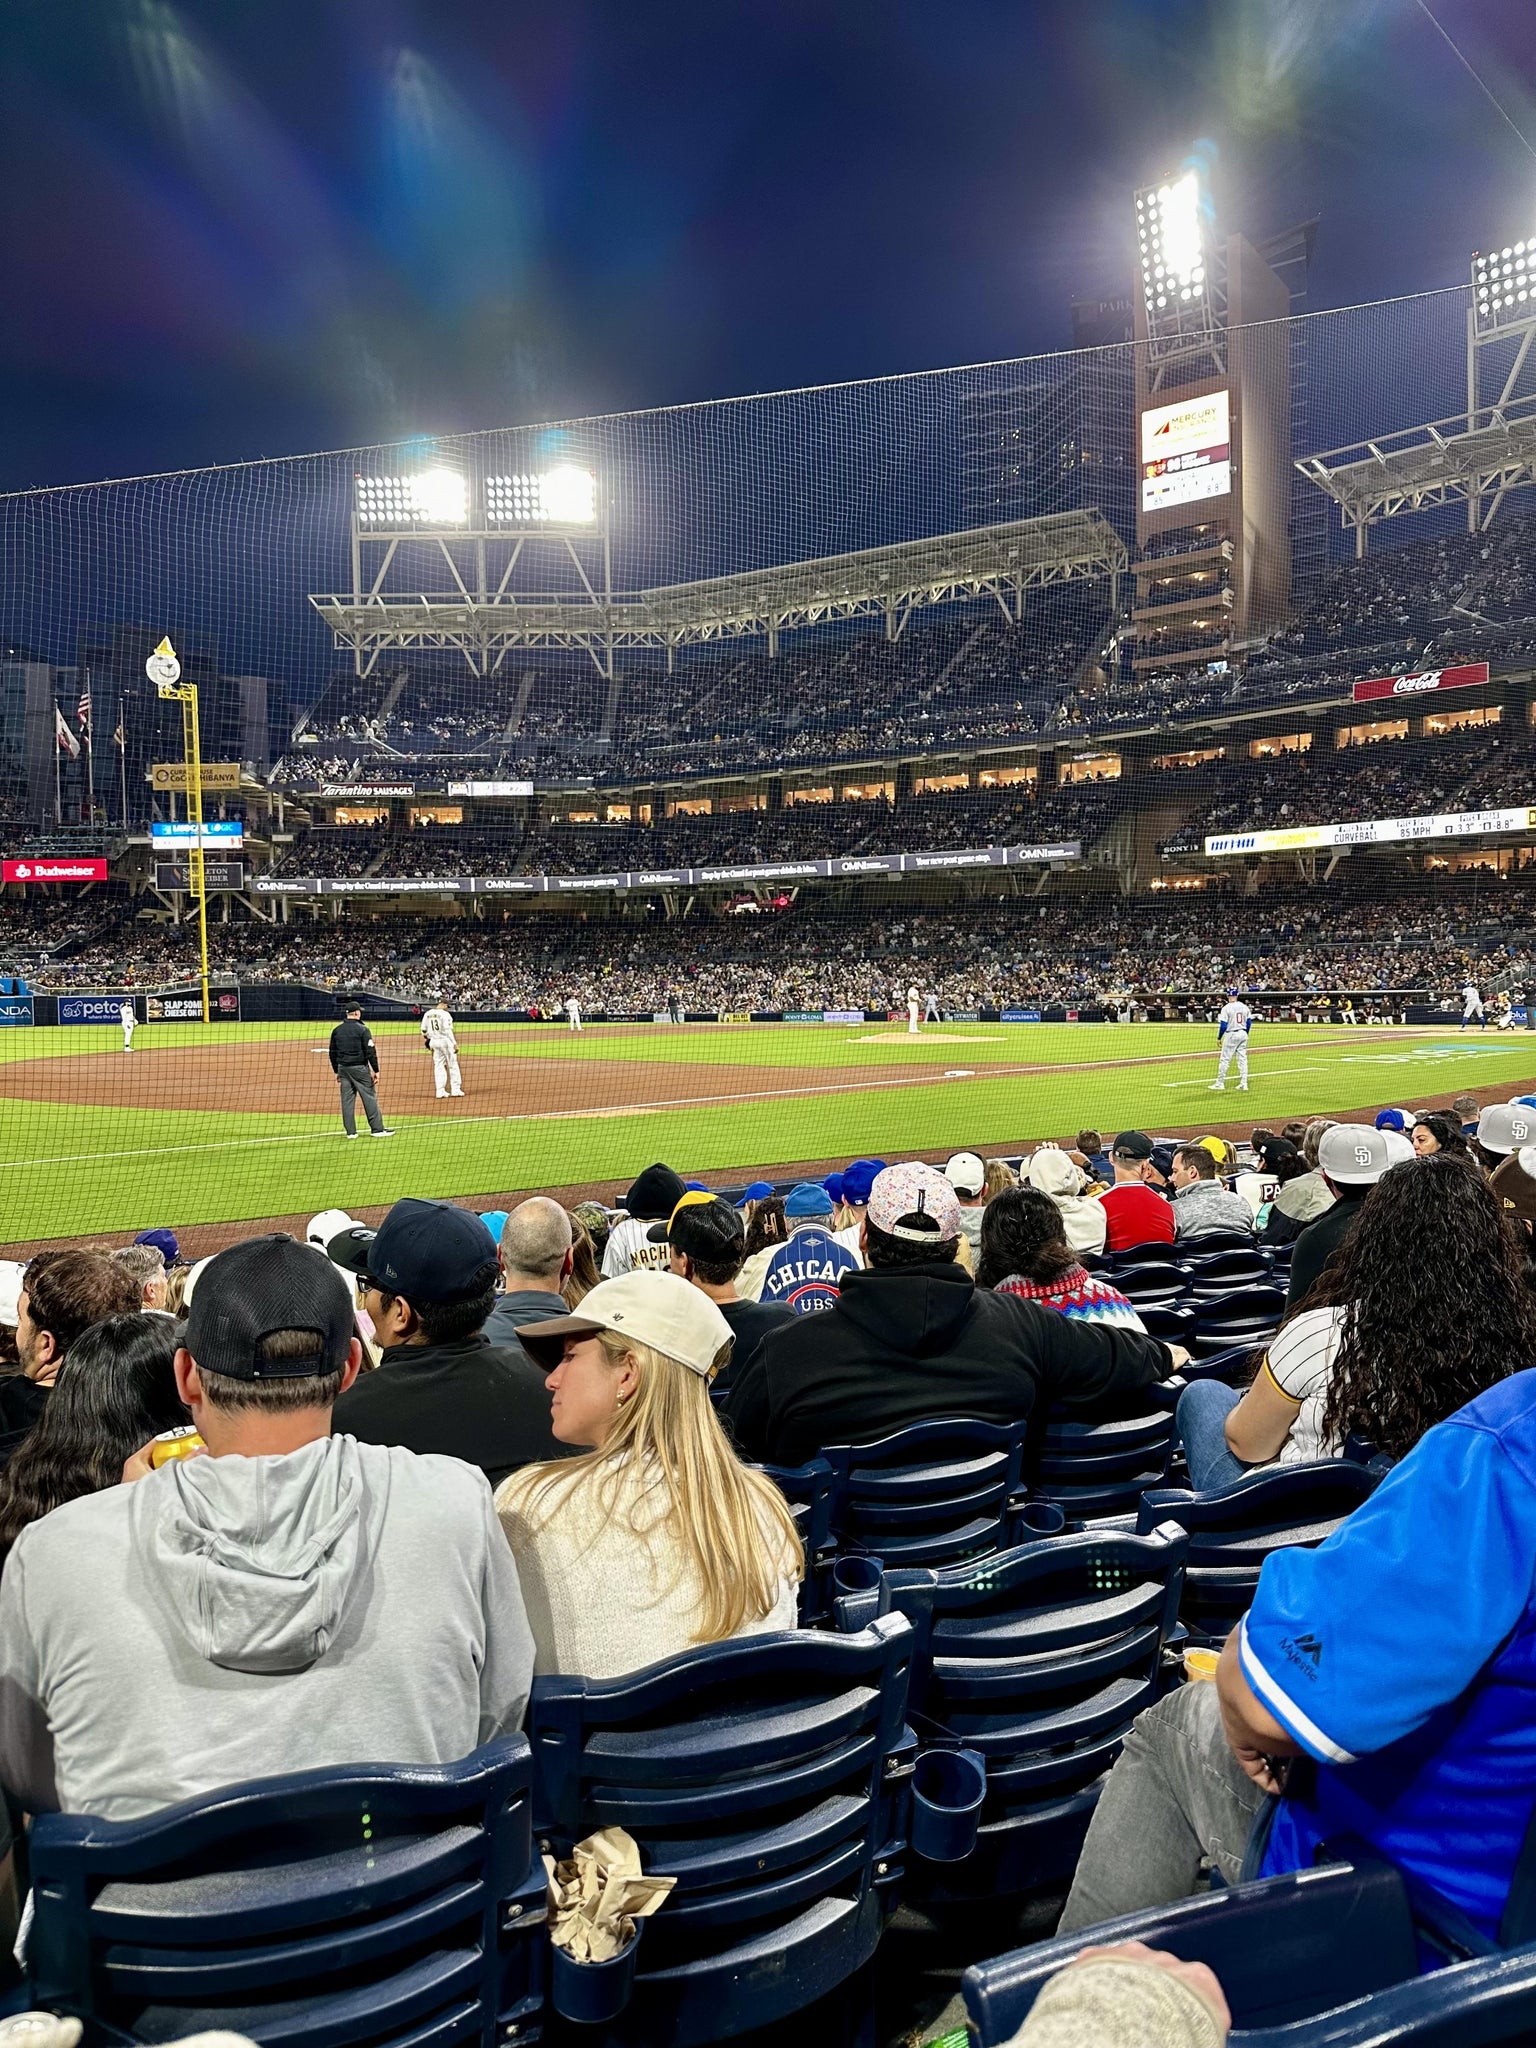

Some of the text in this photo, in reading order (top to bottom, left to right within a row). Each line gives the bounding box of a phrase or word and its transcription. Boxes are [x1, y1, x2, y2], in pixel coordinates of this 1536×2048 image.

[1171, 408, 1217, 423] MERCURY
[191, 773, 235, 782] IHIBANYA
[321, 784, 413, 796] Tarantino SAUSAGES
[1334, 831, 1378, 843] CURVEBALL
[1400, 826, 1431, 838] 85 MPH
[1019, 848, 1047, 859] OMNI
[34, 865, 95, 876] Budweiser
[182, 867, 228, 875] SINLETON
[842, 862, 867, 872] OMNI
[639, 874, 660, 883] OMNI
[256, 882, 283, 891] OMNI
[485, 880, 511, 889] OMNI
[83, 1001, 123, 1015] petc
[164, 1001, 183, 1010] SLAP
[164, 1009, 187, 1018] CHEESE
[187, 1009, 197, 1017] ON
[1002, 1013, 1033, 1021] citycruises
[431, 1019, 440, 1031] 13
[1354, 1146, 1372, 1167] SD
[630, 1245, 671, 1267] MACH
[767, 1259, 852, 1295] CHICA
[1279, 1637, 1318, 1682] Majestic
